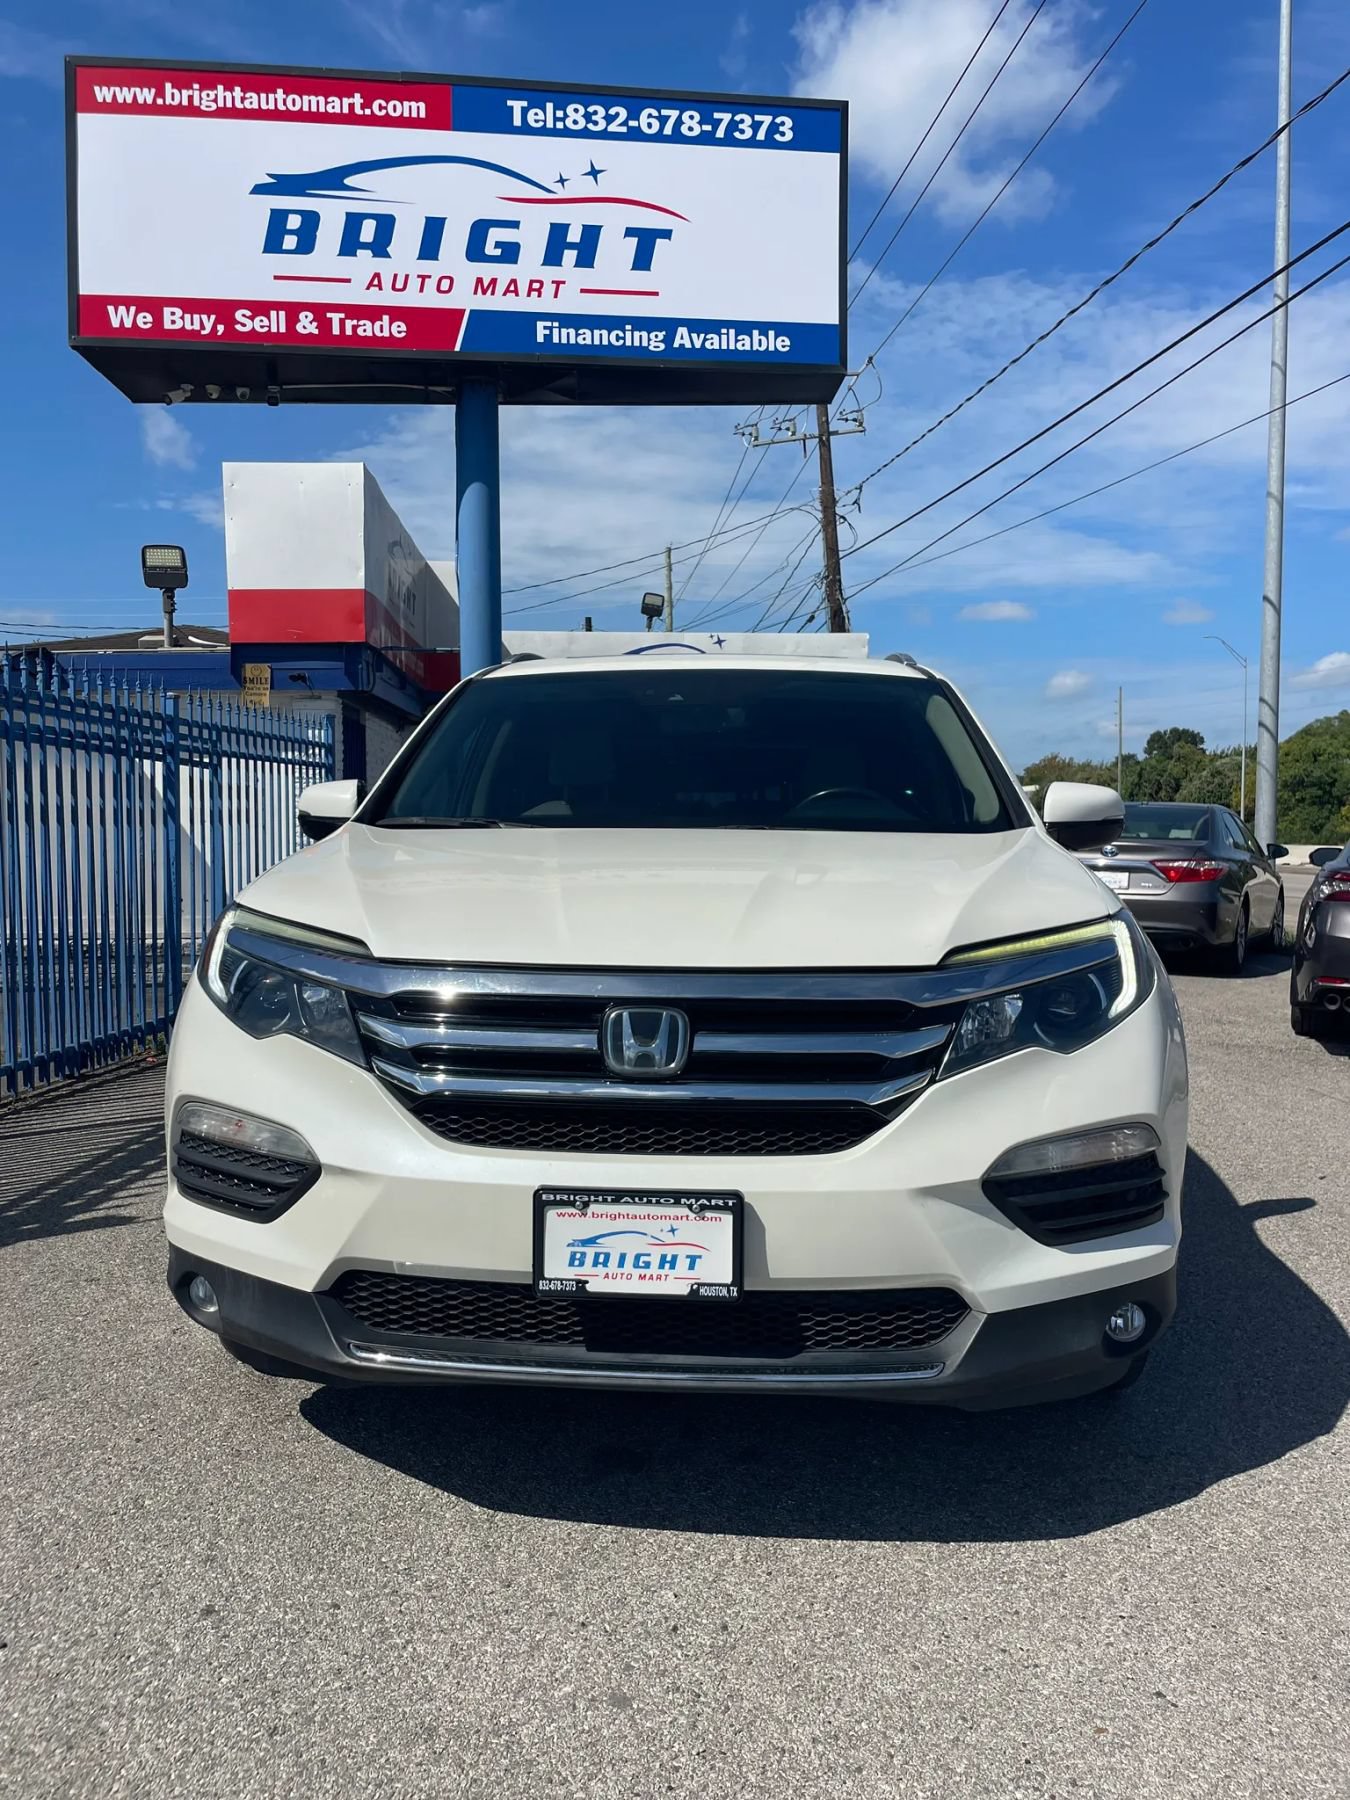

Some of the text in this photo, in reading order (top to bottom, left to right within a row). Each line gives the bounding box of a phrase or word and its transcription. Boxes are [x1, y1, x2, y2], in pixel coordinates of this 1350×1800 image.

[93, 81, 426, 119] www.brightautomart.com
[506, 99, 794, 143] Tel:832-678-7373
[262, 207, 673, 272] BRIGHT
[365, 271, 567, 299] AUTO MART
[106, 305, 407, 338] We Buy, Sell & Trade
[536, 320, 791, 352] Financing Available
[541, 1193, 737, 1207] BRIGHT AUTO MART
[556, 1210, 722, 1223] www.brightautomart.com
[568, 1251, 703, 1272] BRIGHT
[539, 1279, 577, 1291] 832-678-7373
[603, 1272, 670, 1282] AUTO MART
[699, 1285, 738, 1298] HOUSTON, TX
